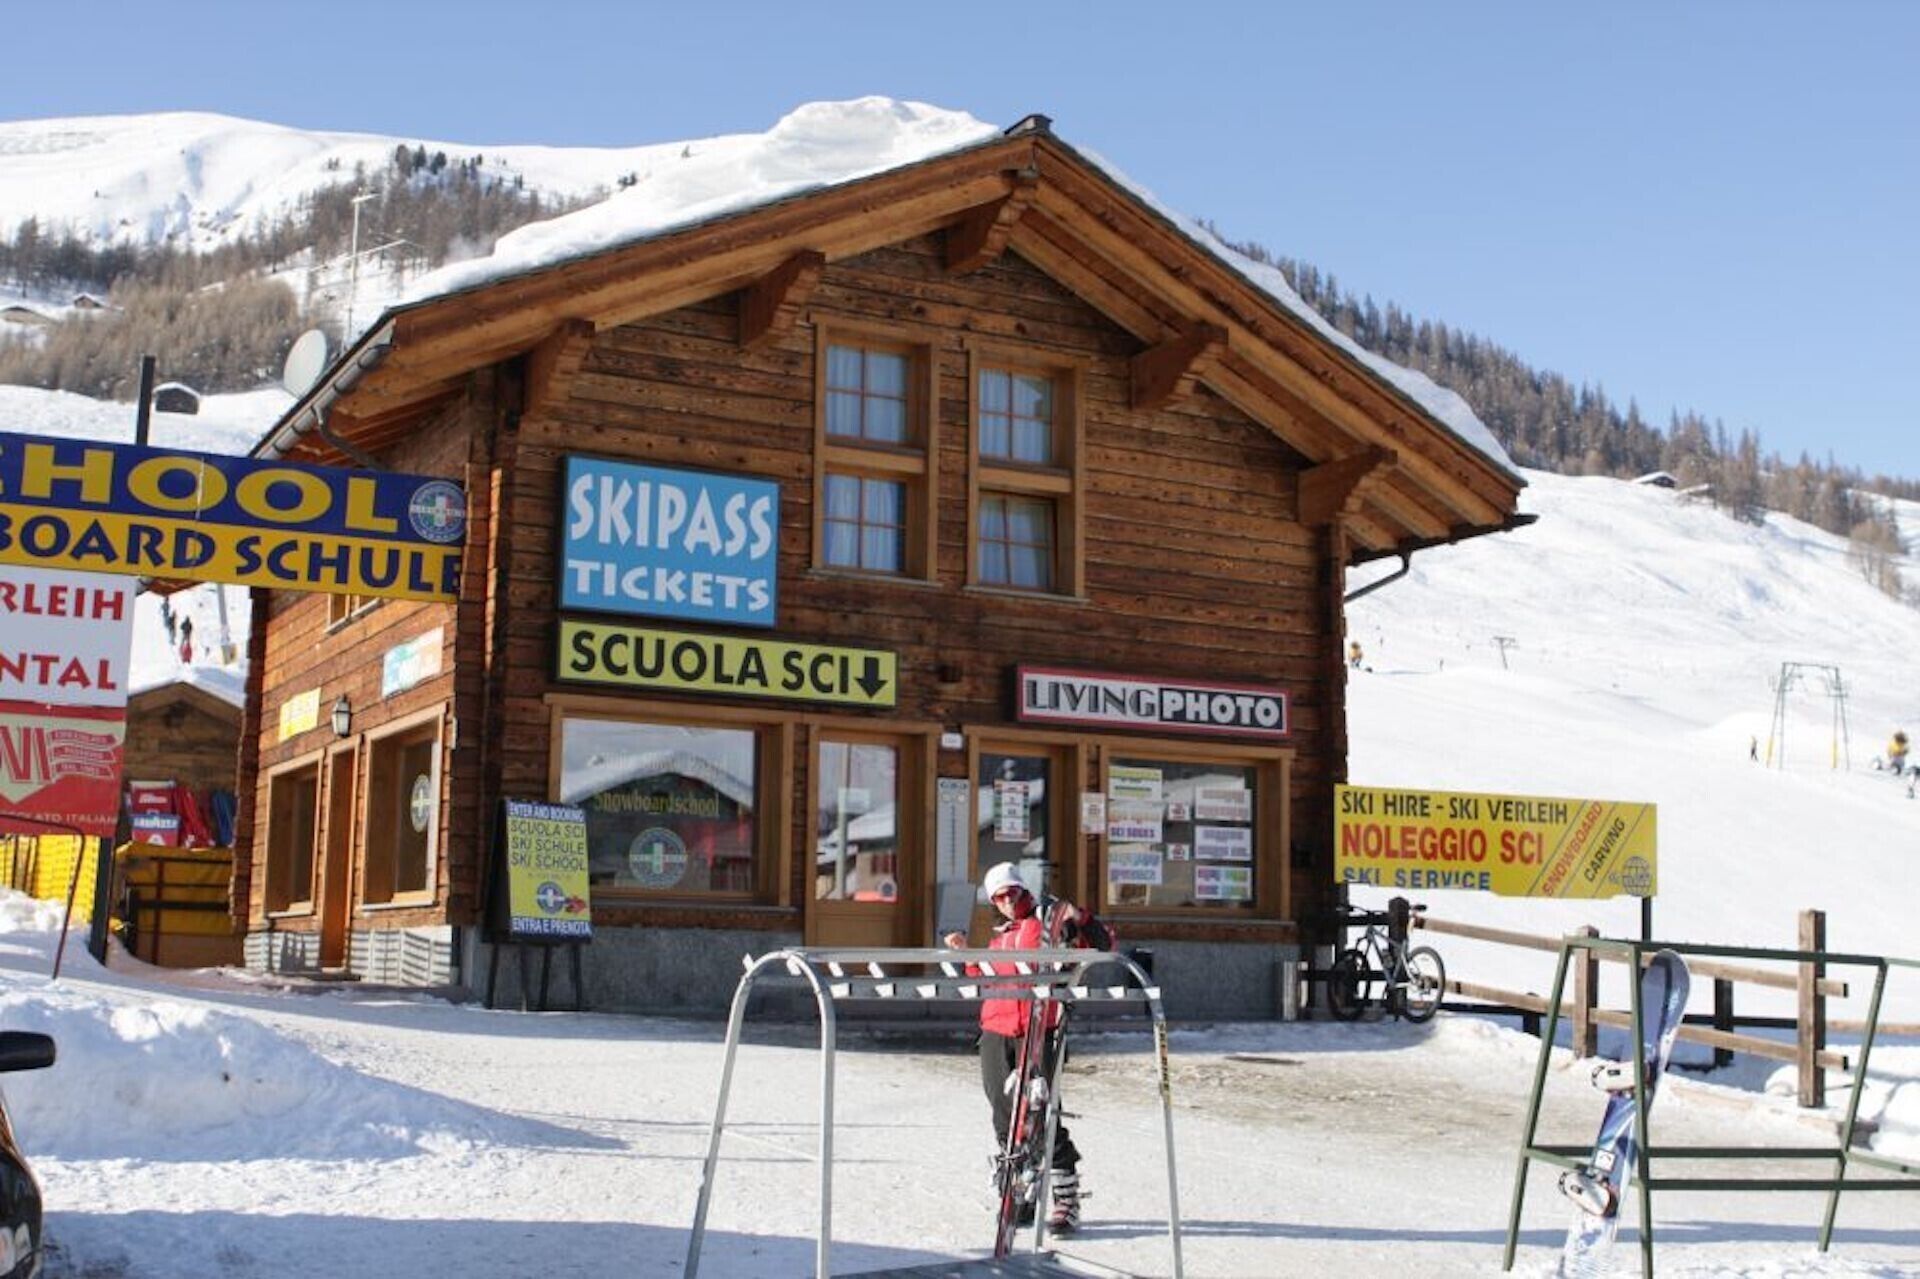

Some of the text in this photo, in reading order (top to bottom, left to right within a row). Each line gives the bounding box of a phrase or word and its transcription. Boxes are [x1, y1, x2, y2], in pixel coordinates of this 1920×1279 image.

[0, 443, 398, 534] HOOL
[569, 473, 772, 561] SKIPASS
[235, 535, 461, 596] SCHULE
[567, 559, 769, 613] TICKETS
[569, 630, 850, 695] SCUOLA SCI
[510, 819, 585, 839] SCUOLA SCI
[1341, 791, 1374, 814] SKI
[1384, 795, 1431, 817] HIRE
[1449, 797, 1479, 820] SKI
[1487, 799, 1568, 825] VERLEIH
[510, 835, 585, 856] SKI SCHULE
[510, 851, 586, 872] SKI SCHOOL
[1341, 823, 1544, 865] NOLEGGIO SCI
[1542, 800, 1602, 897] SNOWBOARD
[1584, 817, 1625, 882] CARVING
[1343, 866, 1491, 891] SKI SERVICE
